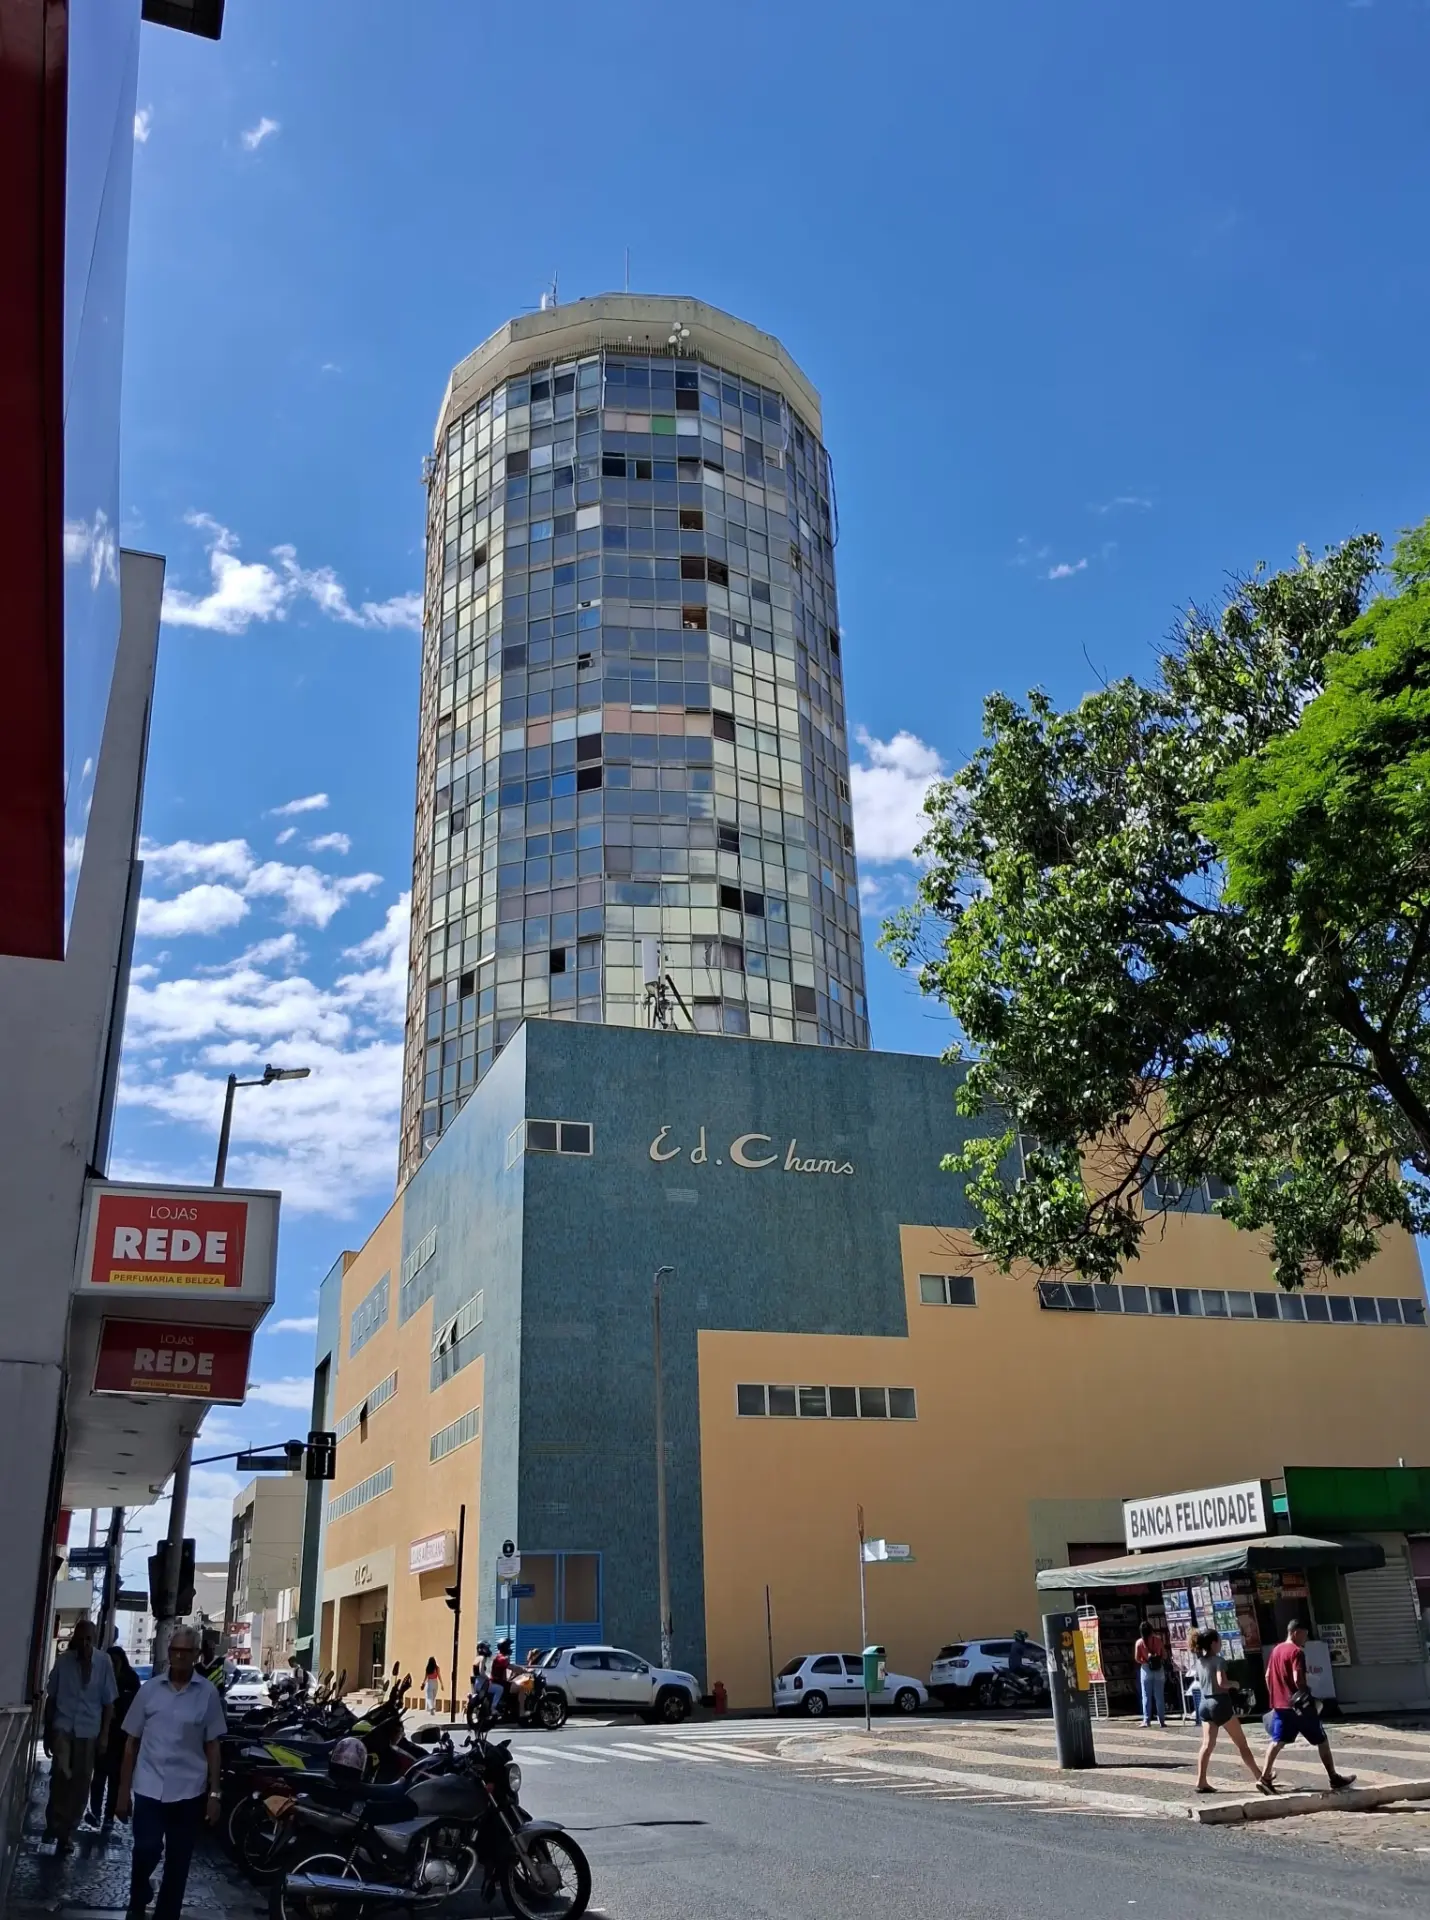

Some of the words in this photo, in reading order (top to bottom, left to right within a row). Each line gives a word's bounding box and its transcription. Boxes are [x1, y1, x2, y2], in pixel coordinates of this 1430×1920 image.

[649, 1125, 723, 1166] Ed.
[730, 1133, 854, 1175] Chams
[150, 1205, 198, 1221] LOJAS
[112, 1226, 228, 1264] REDE
[113, 1274, 175, 1284] PERFUMARIA
[177, 1275, 183, 1284] E
[185, 1276, 221, 1285] BELEZA
[160, 1333, 194, 1346] LOJAS
[133, 1347, 215, 1376] REDE
[1130, 1505, 1173, 1538] BANCA
[1175, 1491, 1258, 1532] FELICIDADE
[1064, 1616, 1073, 1628] P
